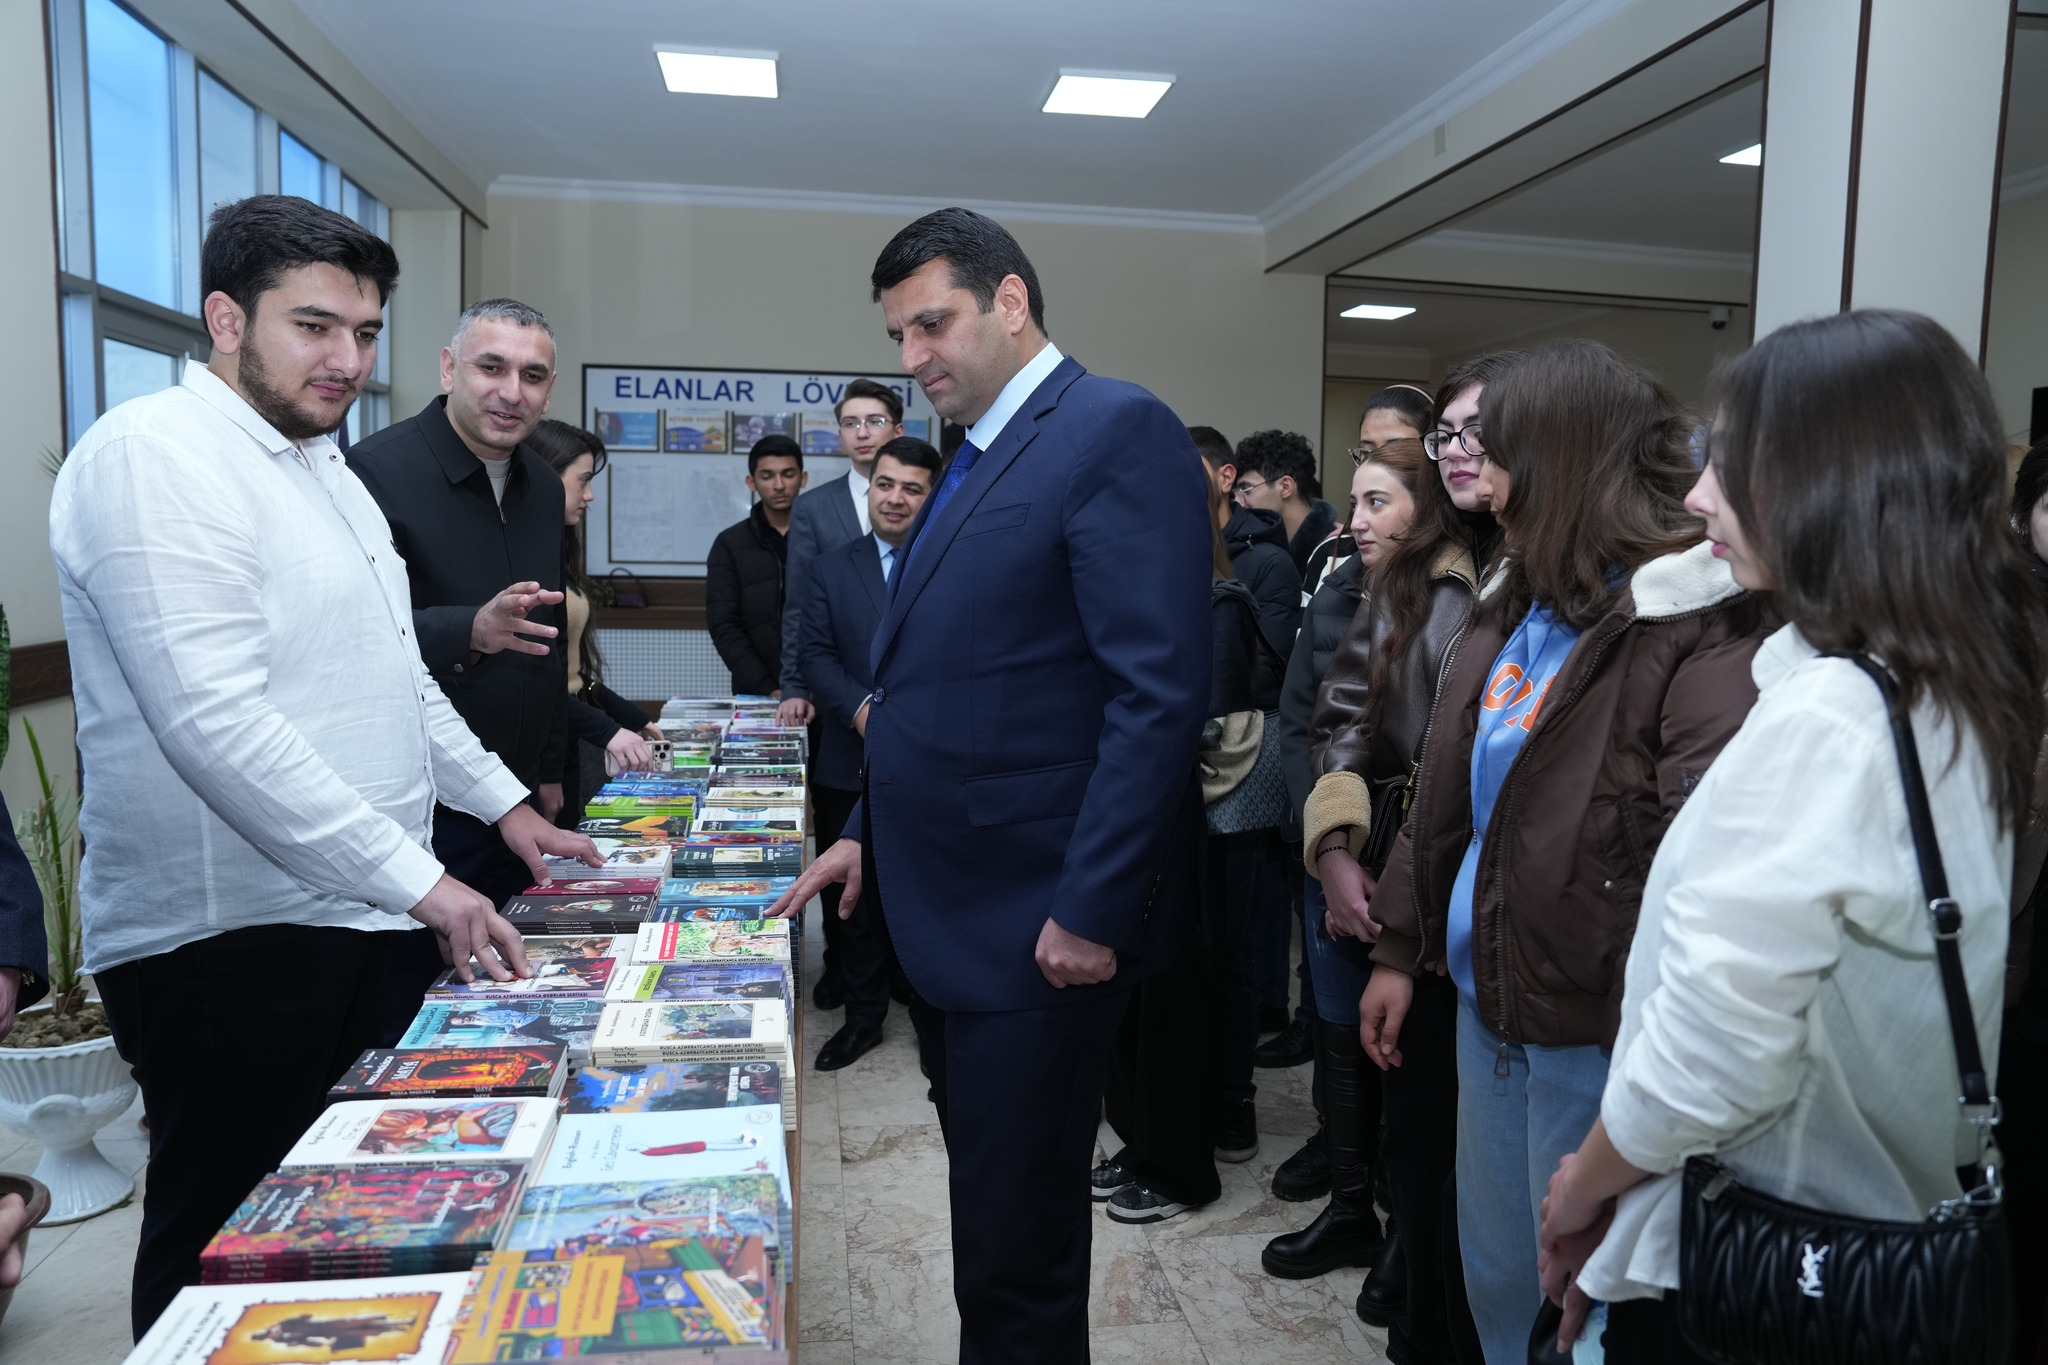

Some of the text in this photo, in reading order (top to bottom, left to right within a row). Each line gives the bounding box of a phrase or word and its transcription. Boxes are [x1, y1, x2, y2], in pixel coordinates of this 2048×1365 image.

[615, 376, 912, 408] ELANLAR LÖVSİ
[390, 1060, 420, 1080] MAYA
